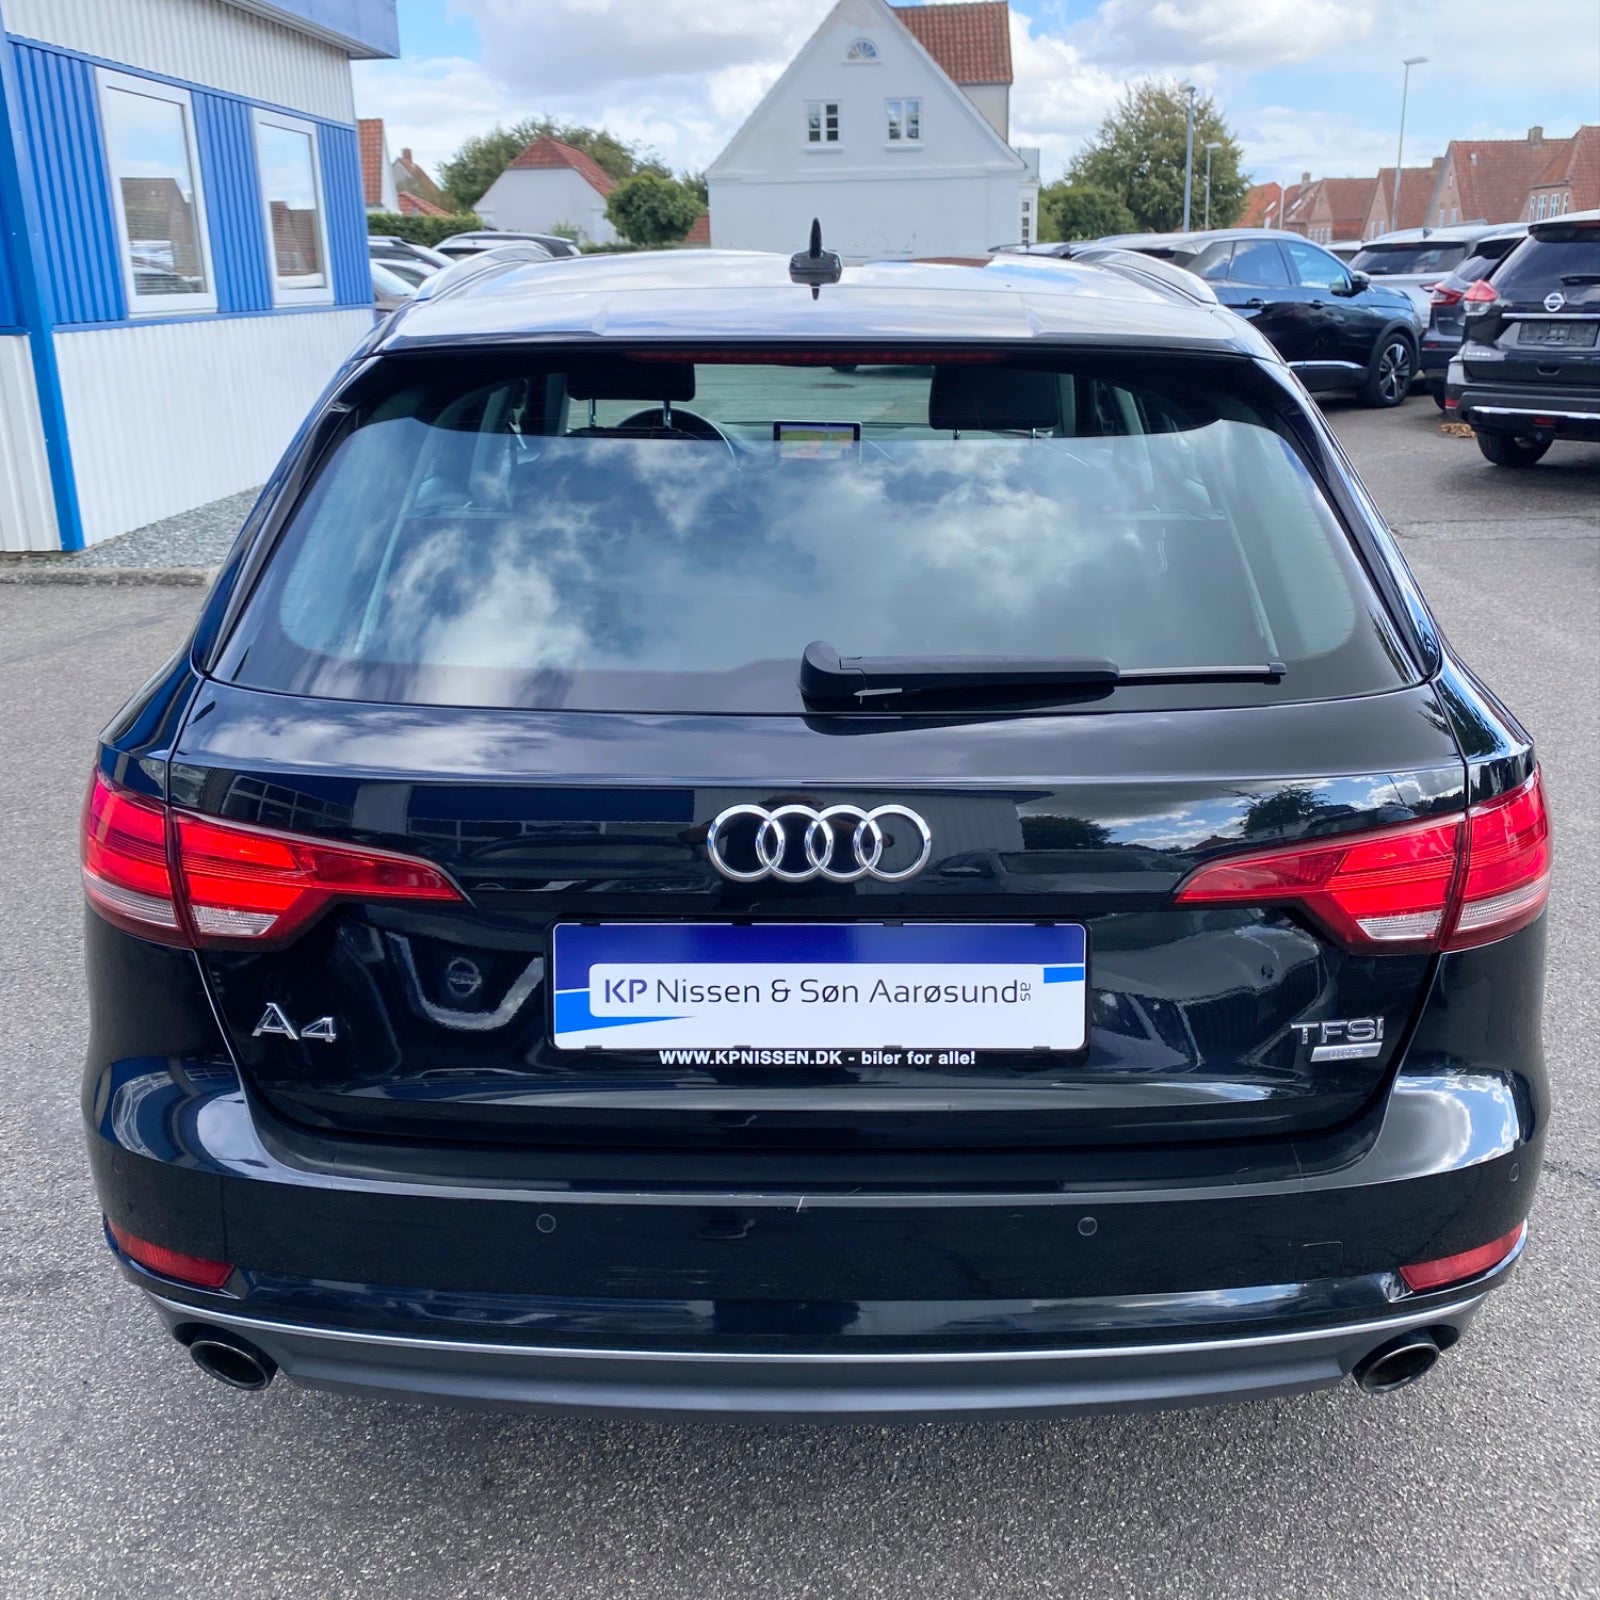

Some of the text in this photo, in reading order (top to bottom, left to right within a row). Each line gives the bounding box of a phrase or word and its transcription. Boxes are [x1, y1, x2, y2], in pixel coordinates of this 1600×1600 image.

[604, 978, 1018, 1004] KP Nissen & Søn Aarøsund
[251, 1002, 337, 1043] A4
[1290, 1016, 1385, 1045] TFSI
[658, 1050, 843, 1066] WWW.KPNISSEN.DK
[861, 1050, 902, 1066] biler
[906, 1050, 933, 1066] for
[937, 1050, 976, 1066] alle!
